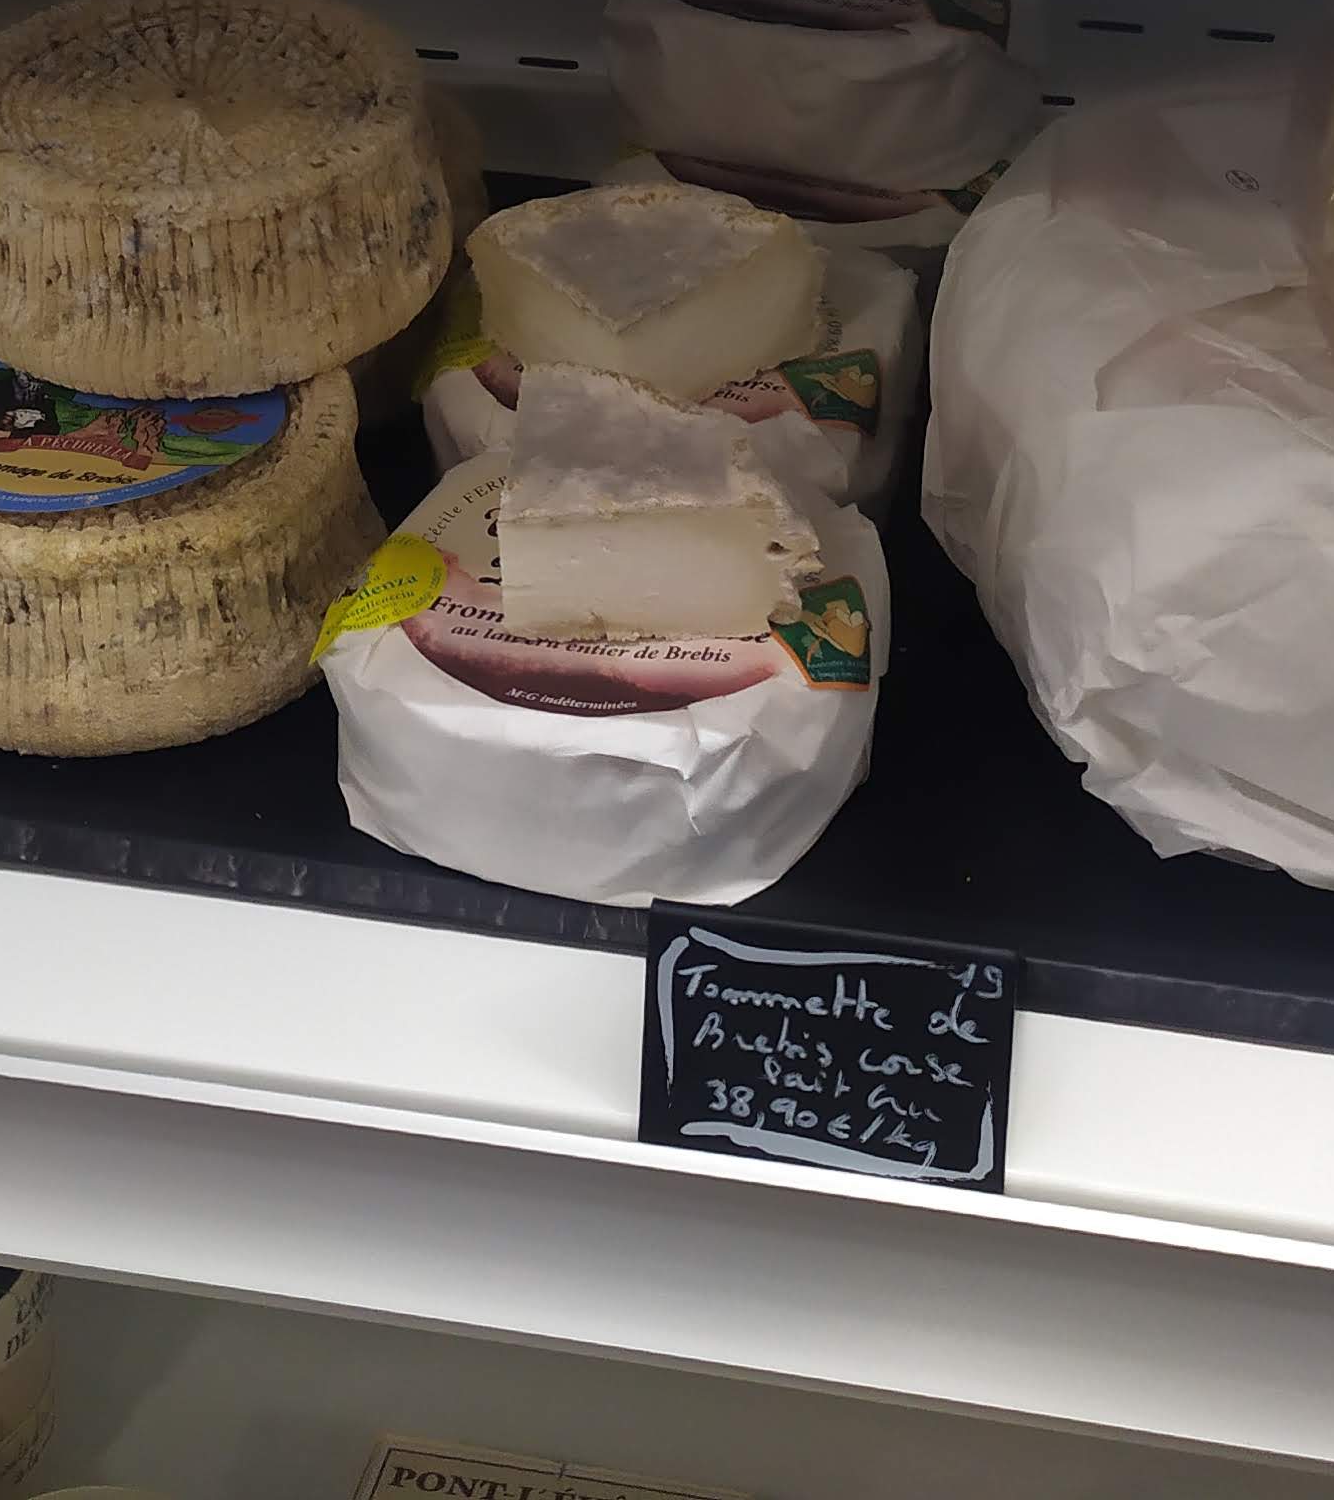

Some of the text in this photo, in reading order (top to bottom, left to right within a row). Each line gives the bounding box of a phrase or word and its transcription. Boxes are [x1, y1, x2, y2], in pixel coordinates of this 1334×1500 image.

[422, 504, 463, 545] Cécile
[427, 596, 506, 624] From
[451, 624, 479, 638] au
[564, 640, 627, 660] entier
[634, 644, 660, 661] de
[664, 645, 733, 664] Brebis
[927, 992, 992, 1044] de
[693, 1012, 833, 1068] Brebis
